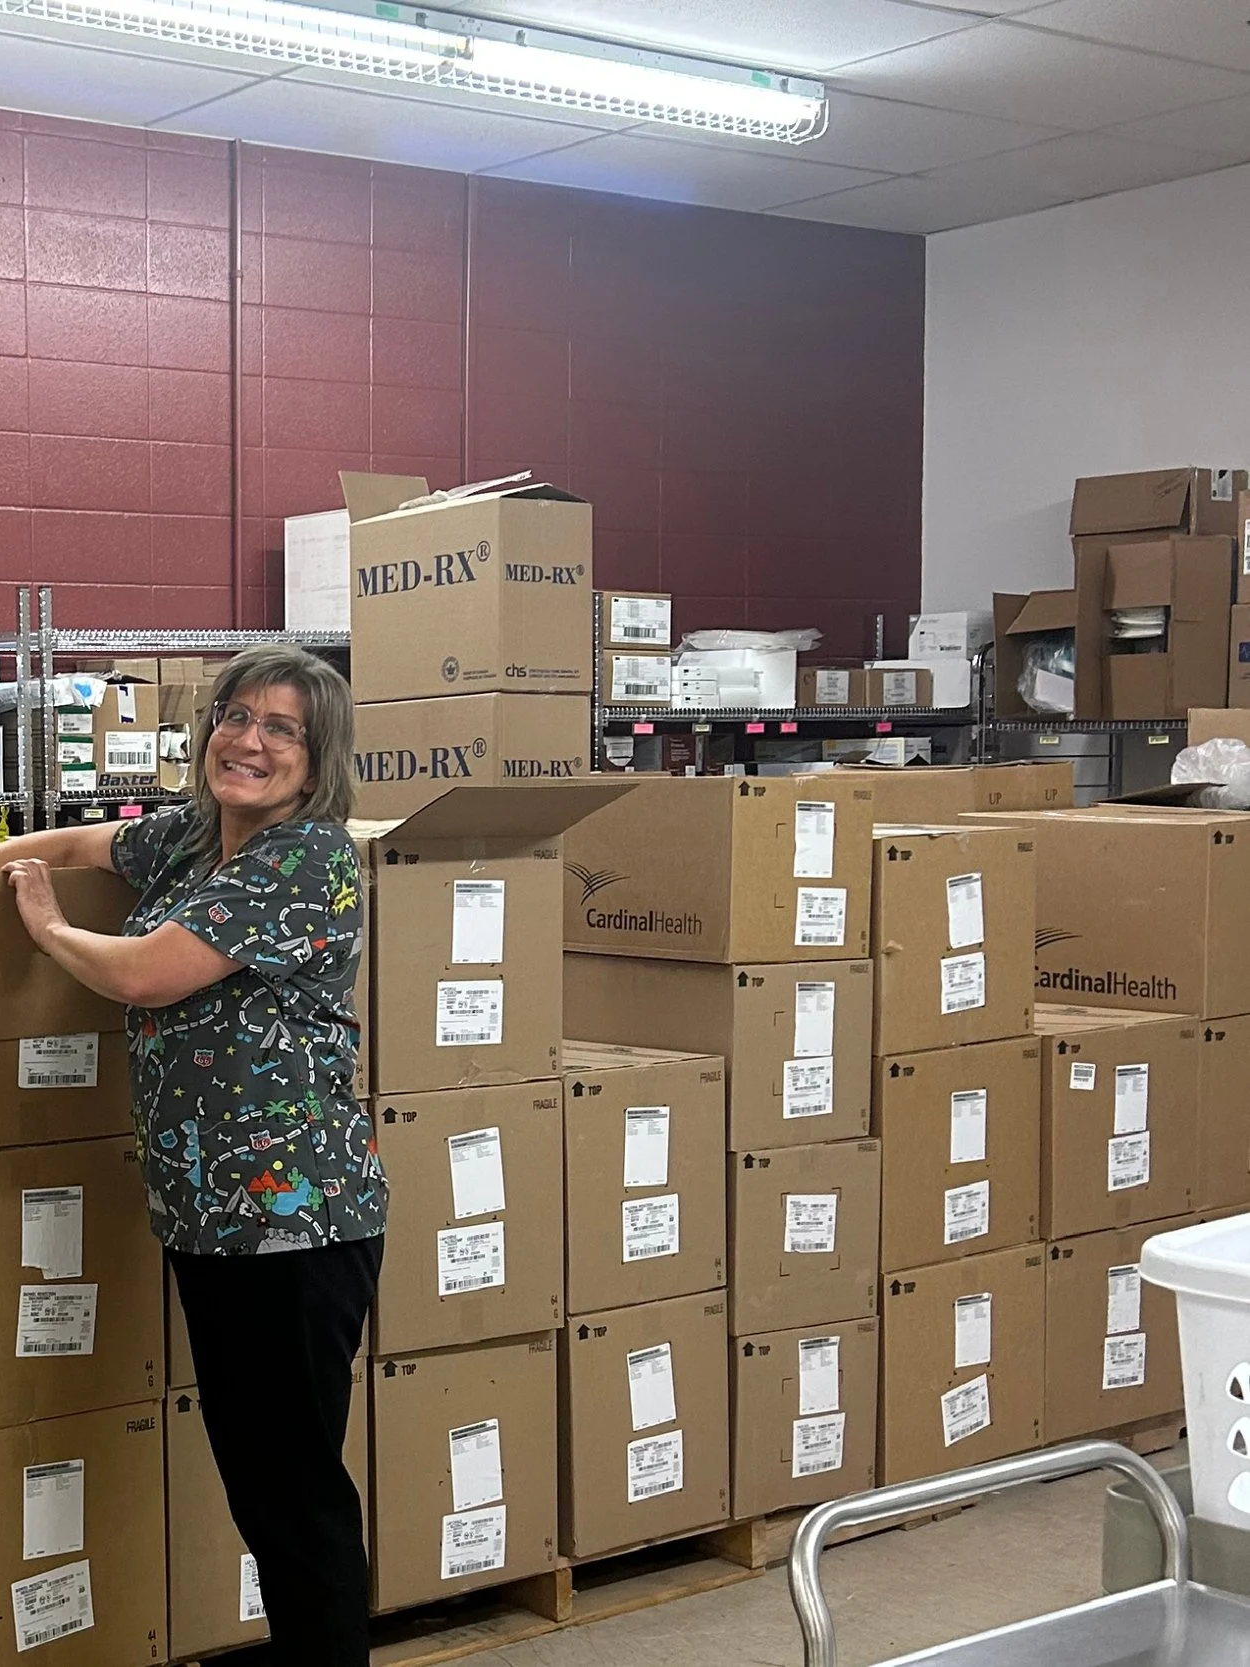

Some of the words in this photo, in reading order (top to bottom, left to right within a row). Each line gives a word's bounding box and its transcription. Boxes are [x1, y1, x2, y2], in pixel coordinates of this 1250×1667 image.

[99, 774, 157, 787] Baxter
[405, 853, 419, 866] TOP
[588, 1084, 602, 1096] TOP
[401, 1110, 417, 1123] TOP
[593, 1325, 607, 1338] TOP
[528, 1338, 553, 1354] FRAGILE
[402, 1363, 417, 1377] TOP
[148, 1375, 155, 1388] G
[126, 1416, 156, 1434] FRAGILE
[151, 1645, 157, 1658] G
